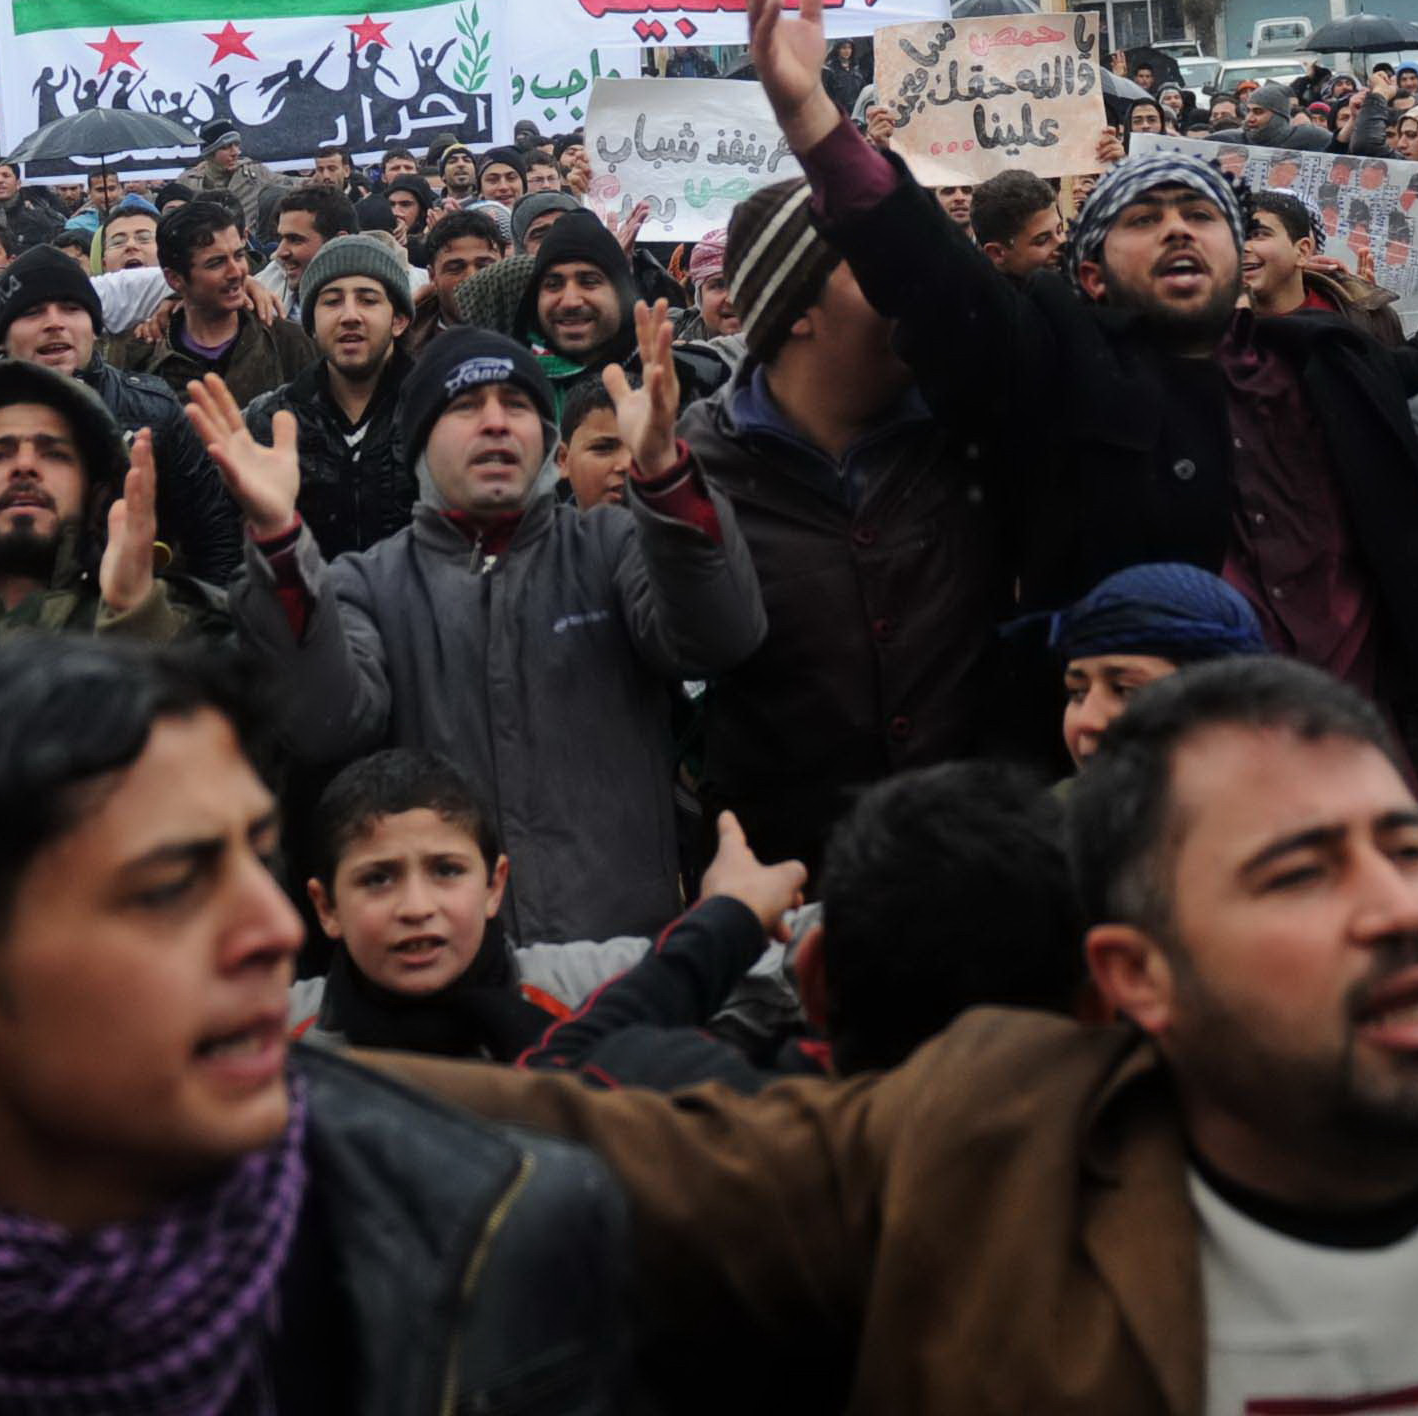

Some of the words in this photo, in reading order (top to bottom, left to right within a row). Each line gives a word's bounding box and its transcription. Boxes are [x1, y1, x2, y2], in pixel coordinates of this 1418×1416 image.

[968, 25, 1066, 57] حمص
[1073, 14, 1095, 60] يا
[318, 92, 488, 148] احرار
[595, 113, 700, 174] شباب
[973, 102, 1060, 156] علينا
